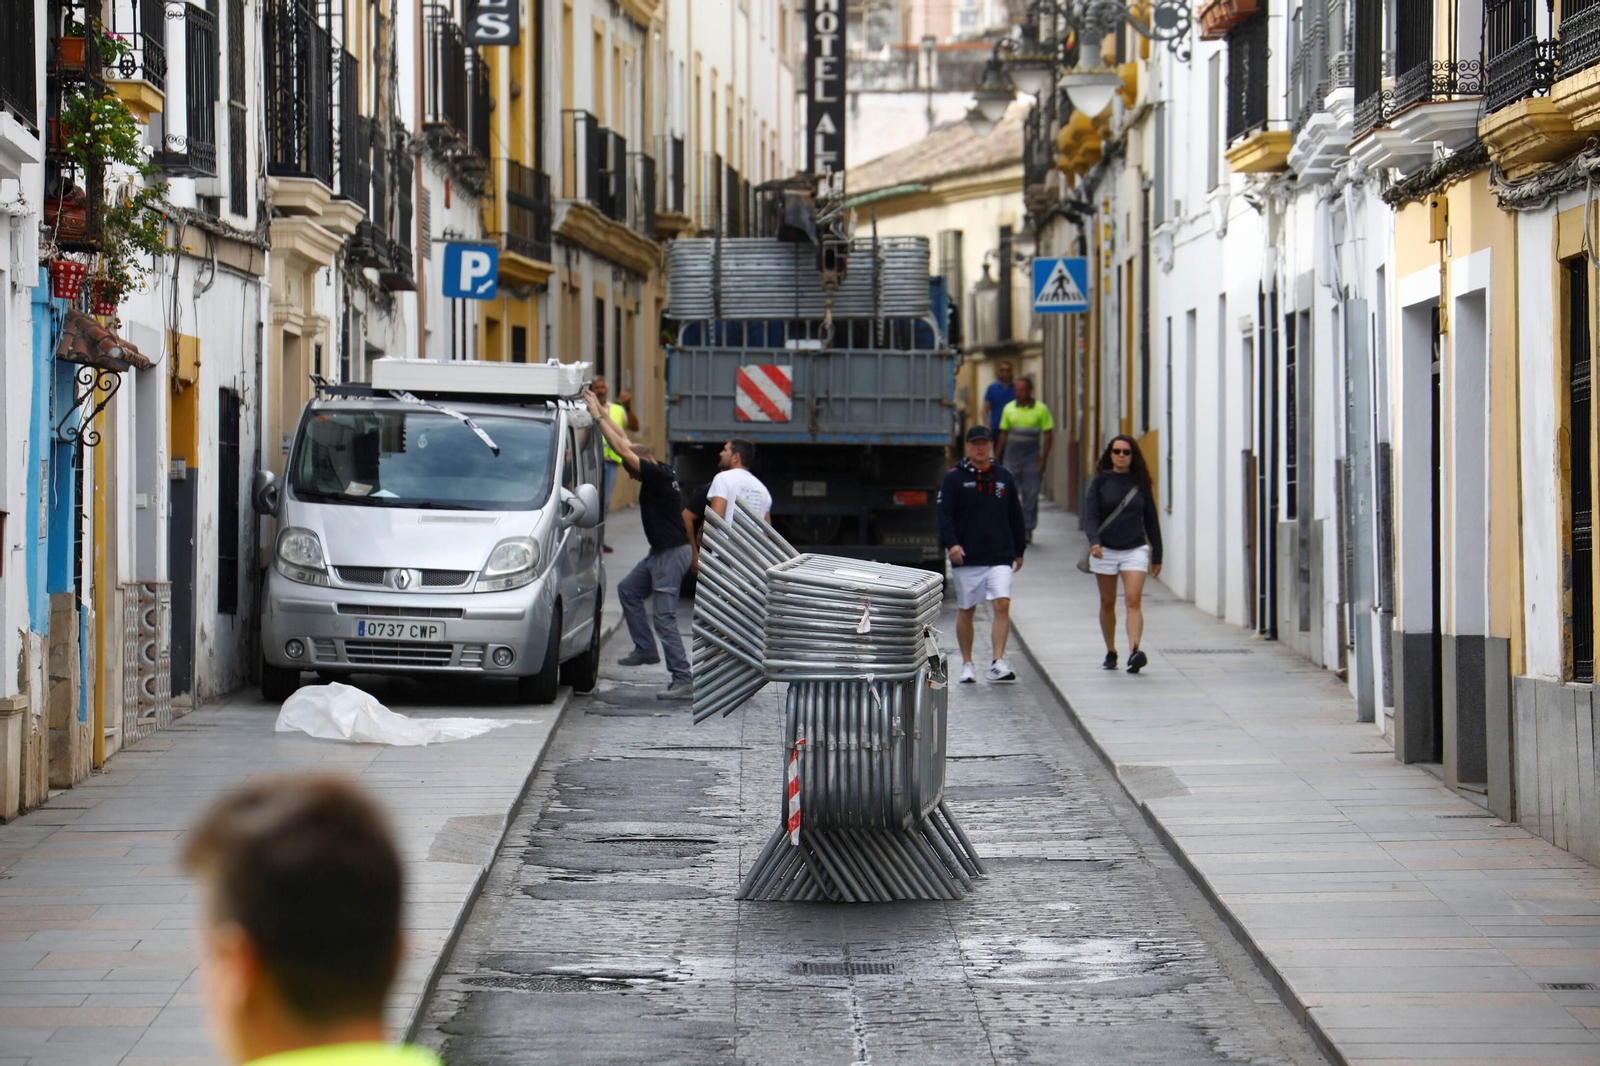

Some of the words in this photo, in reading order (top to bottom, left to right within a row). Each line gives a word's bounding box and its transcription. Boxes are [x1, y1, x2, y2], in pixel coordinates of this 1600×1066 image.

[460, 250, 491, 291] P
[368, 622, 405, 637] 0737
[410, 624, 438, 639] CWP
